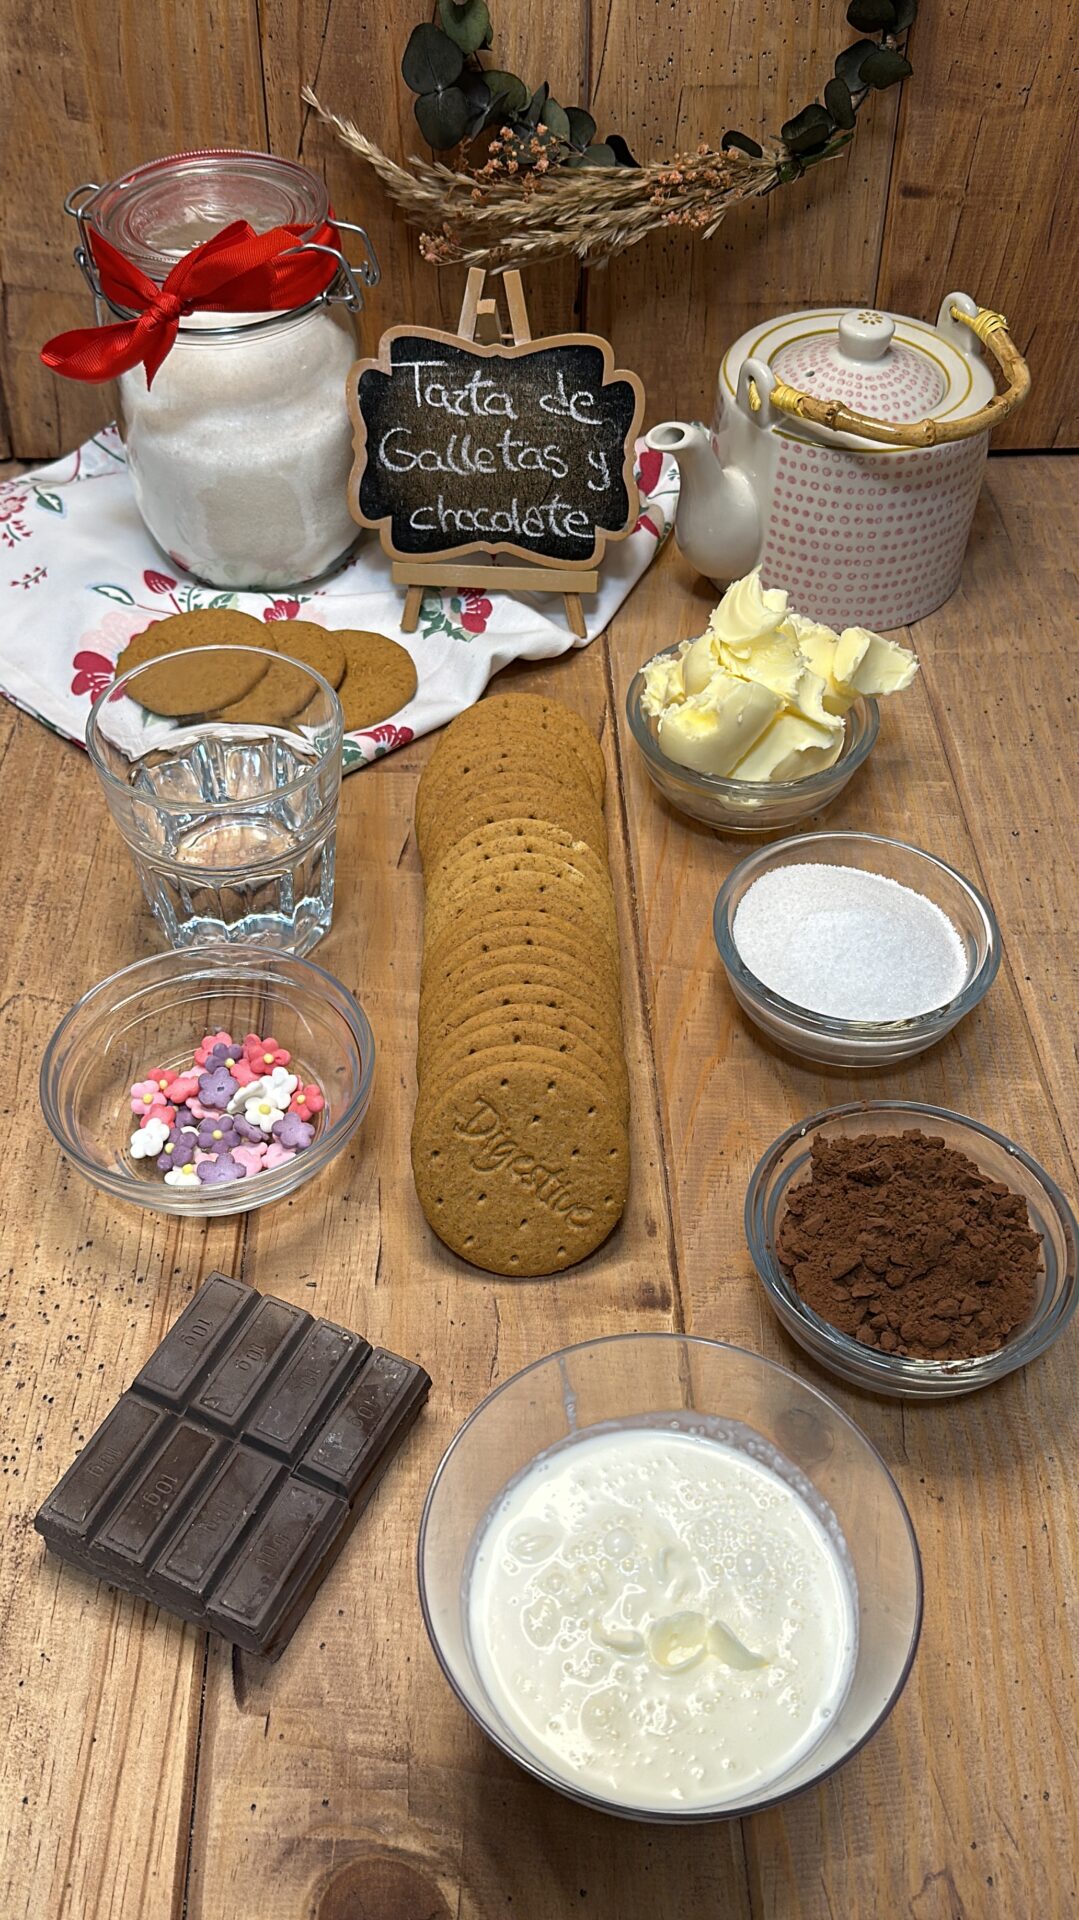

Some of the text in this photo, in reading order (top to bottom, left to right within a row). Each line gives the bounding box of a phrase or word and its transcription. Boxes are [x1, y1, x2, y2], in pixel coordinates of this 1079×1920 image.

[389, 360, 603, 425] Tarta de
[380, 427, 611, 491] Galletas y
[409, 494, 595, 538] chocolate
